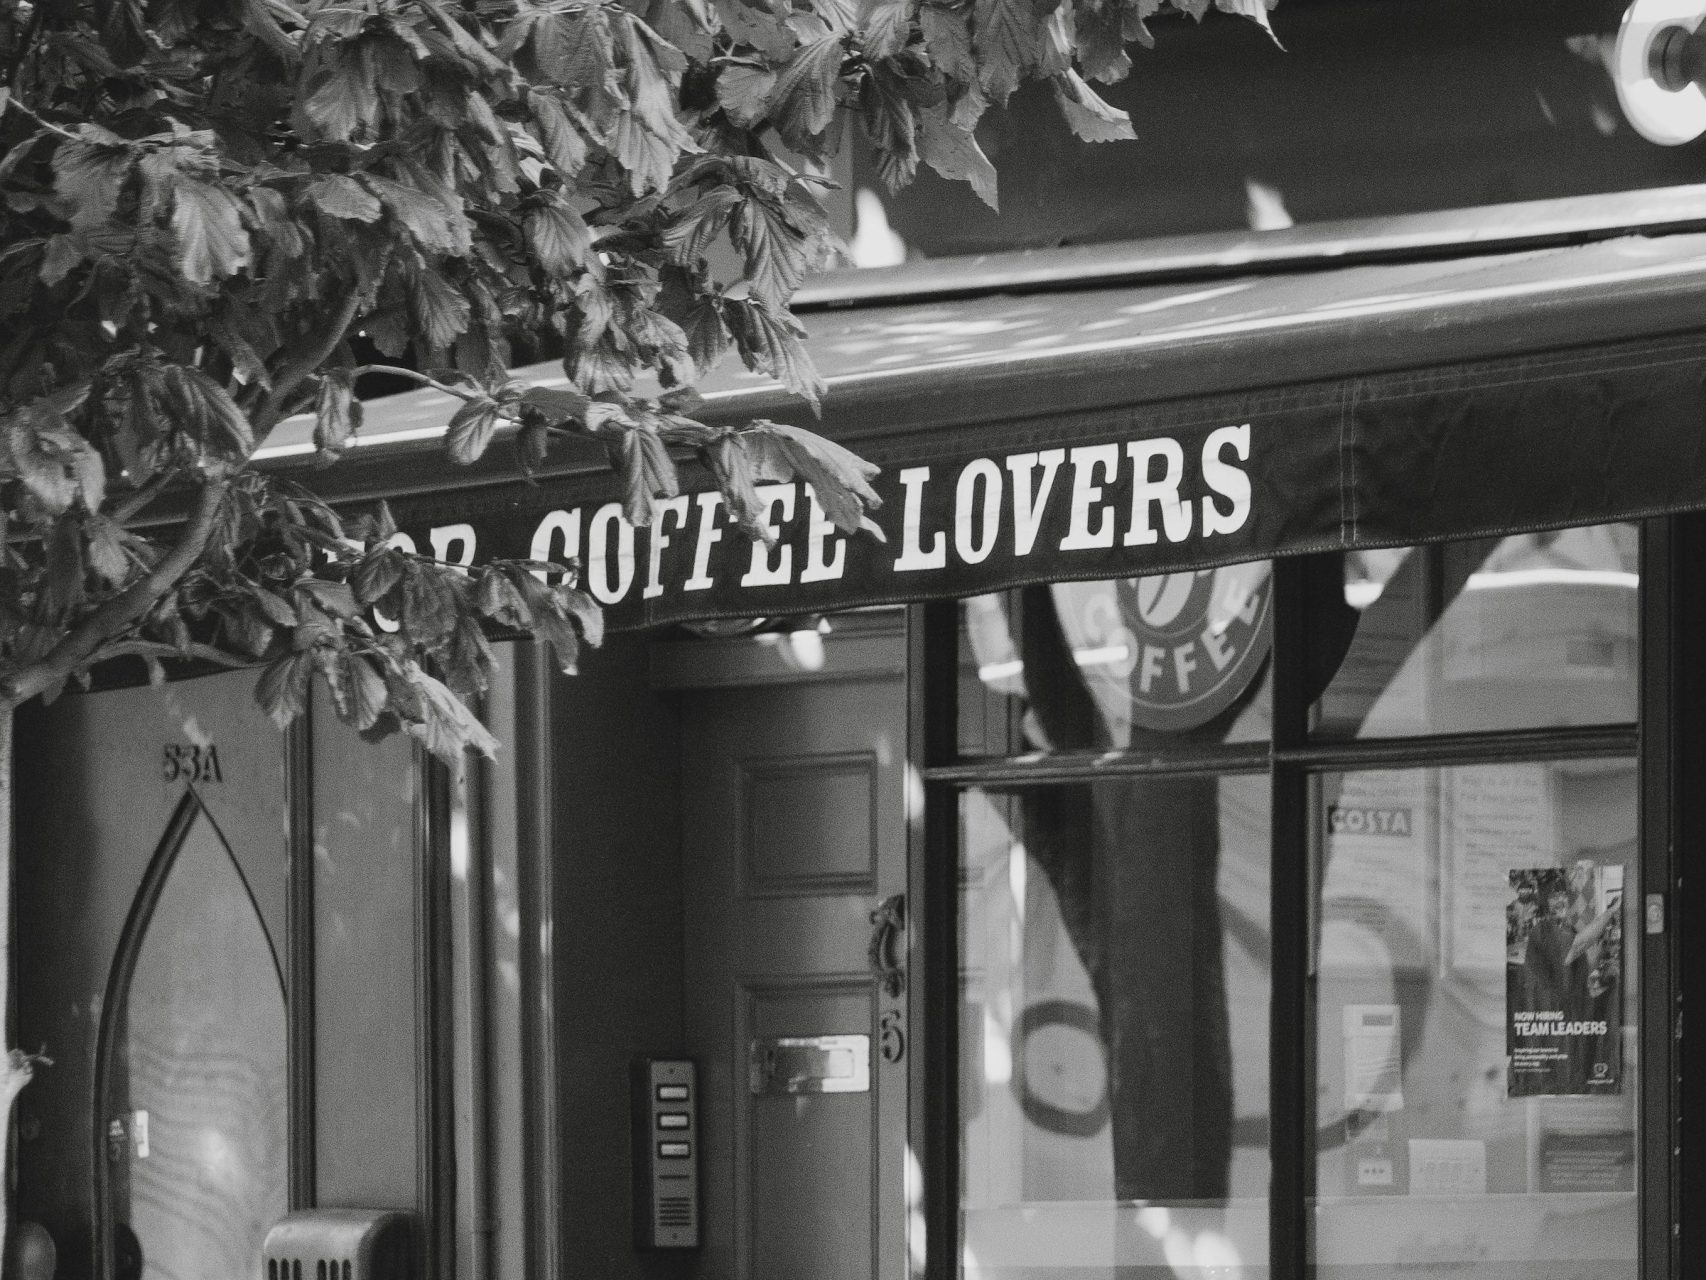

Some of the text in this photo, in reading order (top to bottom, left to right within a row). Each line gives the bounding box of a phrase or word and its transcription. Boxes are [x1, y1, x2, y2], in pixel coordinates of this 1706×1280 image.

[894, 424, 1252, 572] LOVERS
[1514, 1021, 1607, 1036] TEAM LEADERS
